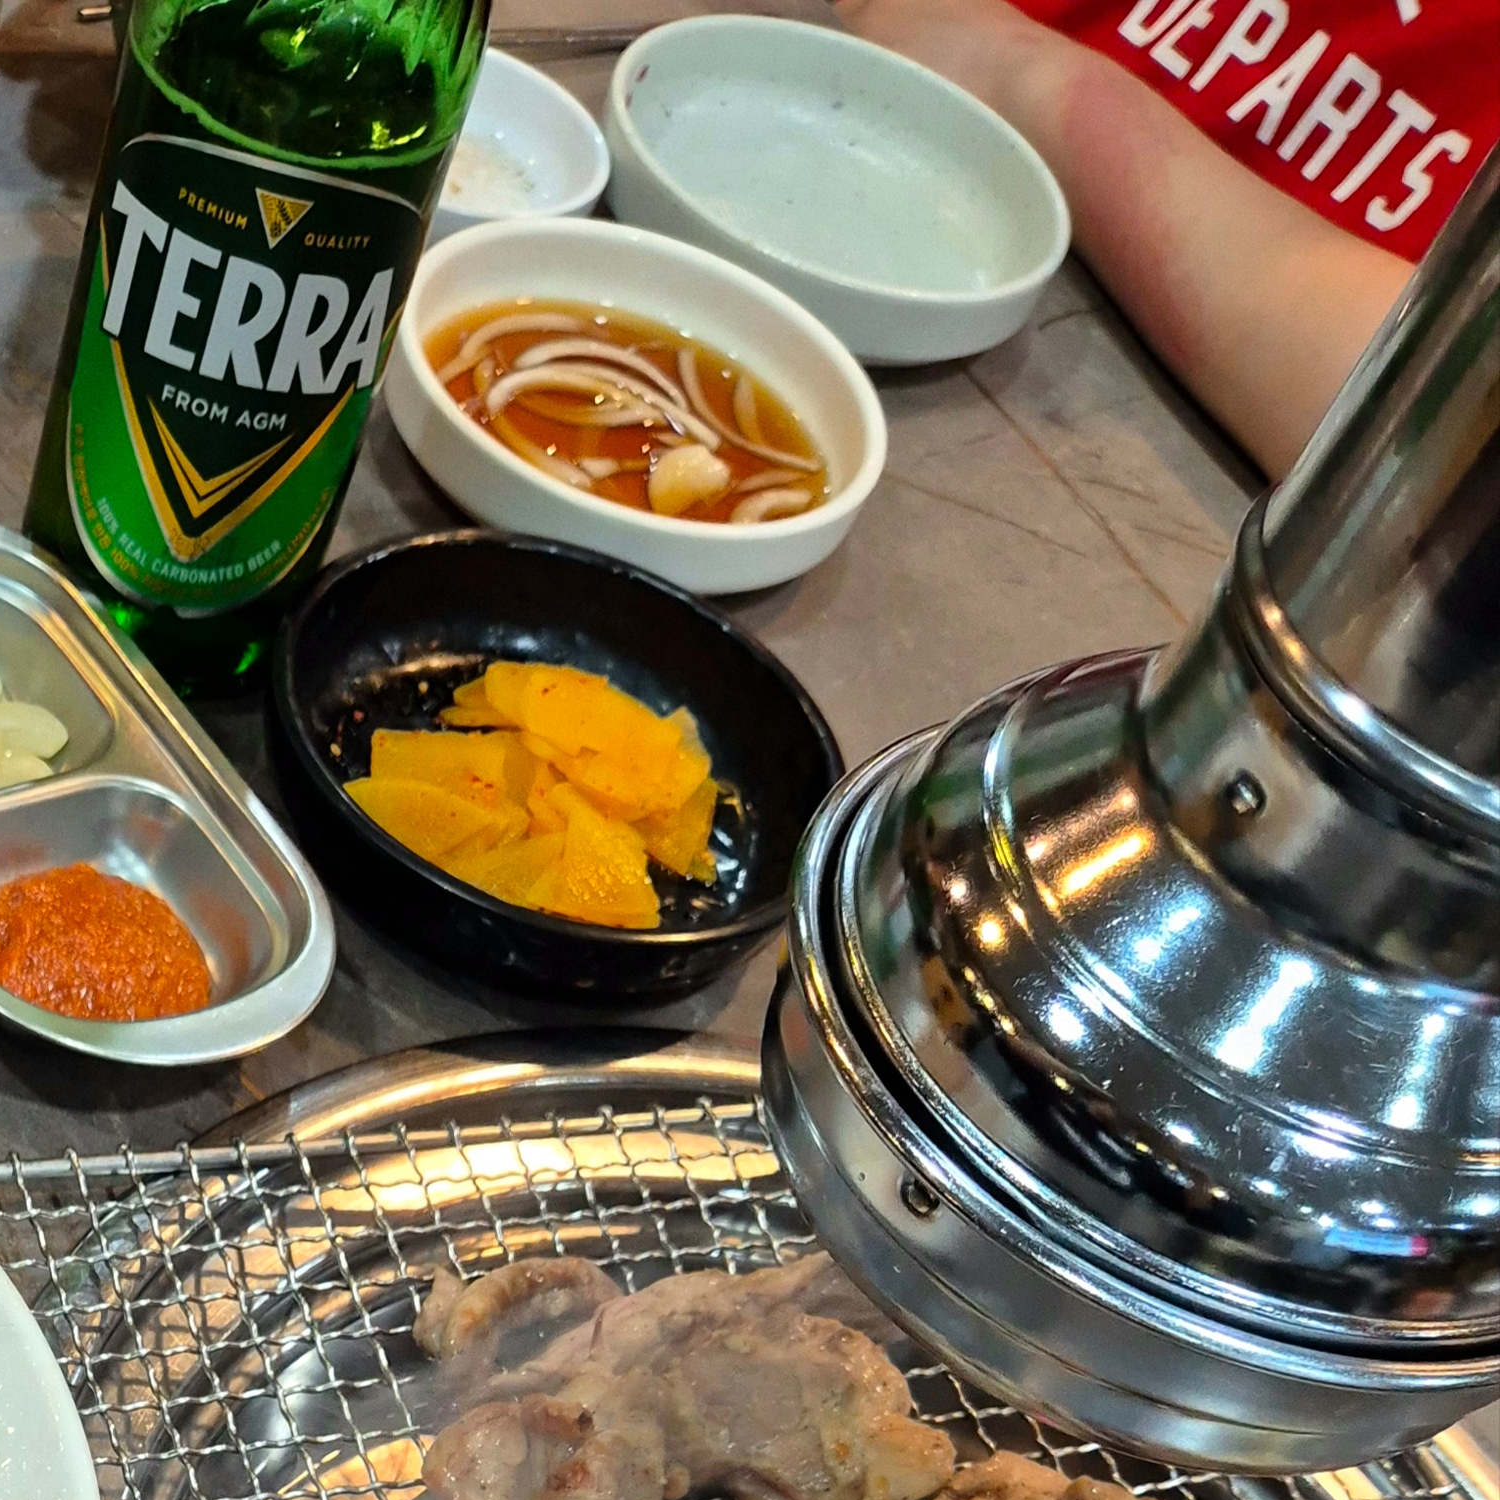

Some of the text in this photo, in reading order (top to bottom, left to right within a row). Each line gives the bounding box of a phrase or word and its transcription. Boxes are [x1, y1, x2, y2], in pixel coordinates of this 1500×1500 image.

[178, 186, 373, 251] PREMIUM QUALITY
[102, 179, 395, 396] TERRA
[160, 383, 289, 433] FROM AGM
[118, 531, 148, 570] REAL
[150, 558, 245, 586] CARBONATED
[246, 539, 283, 573] BEER
